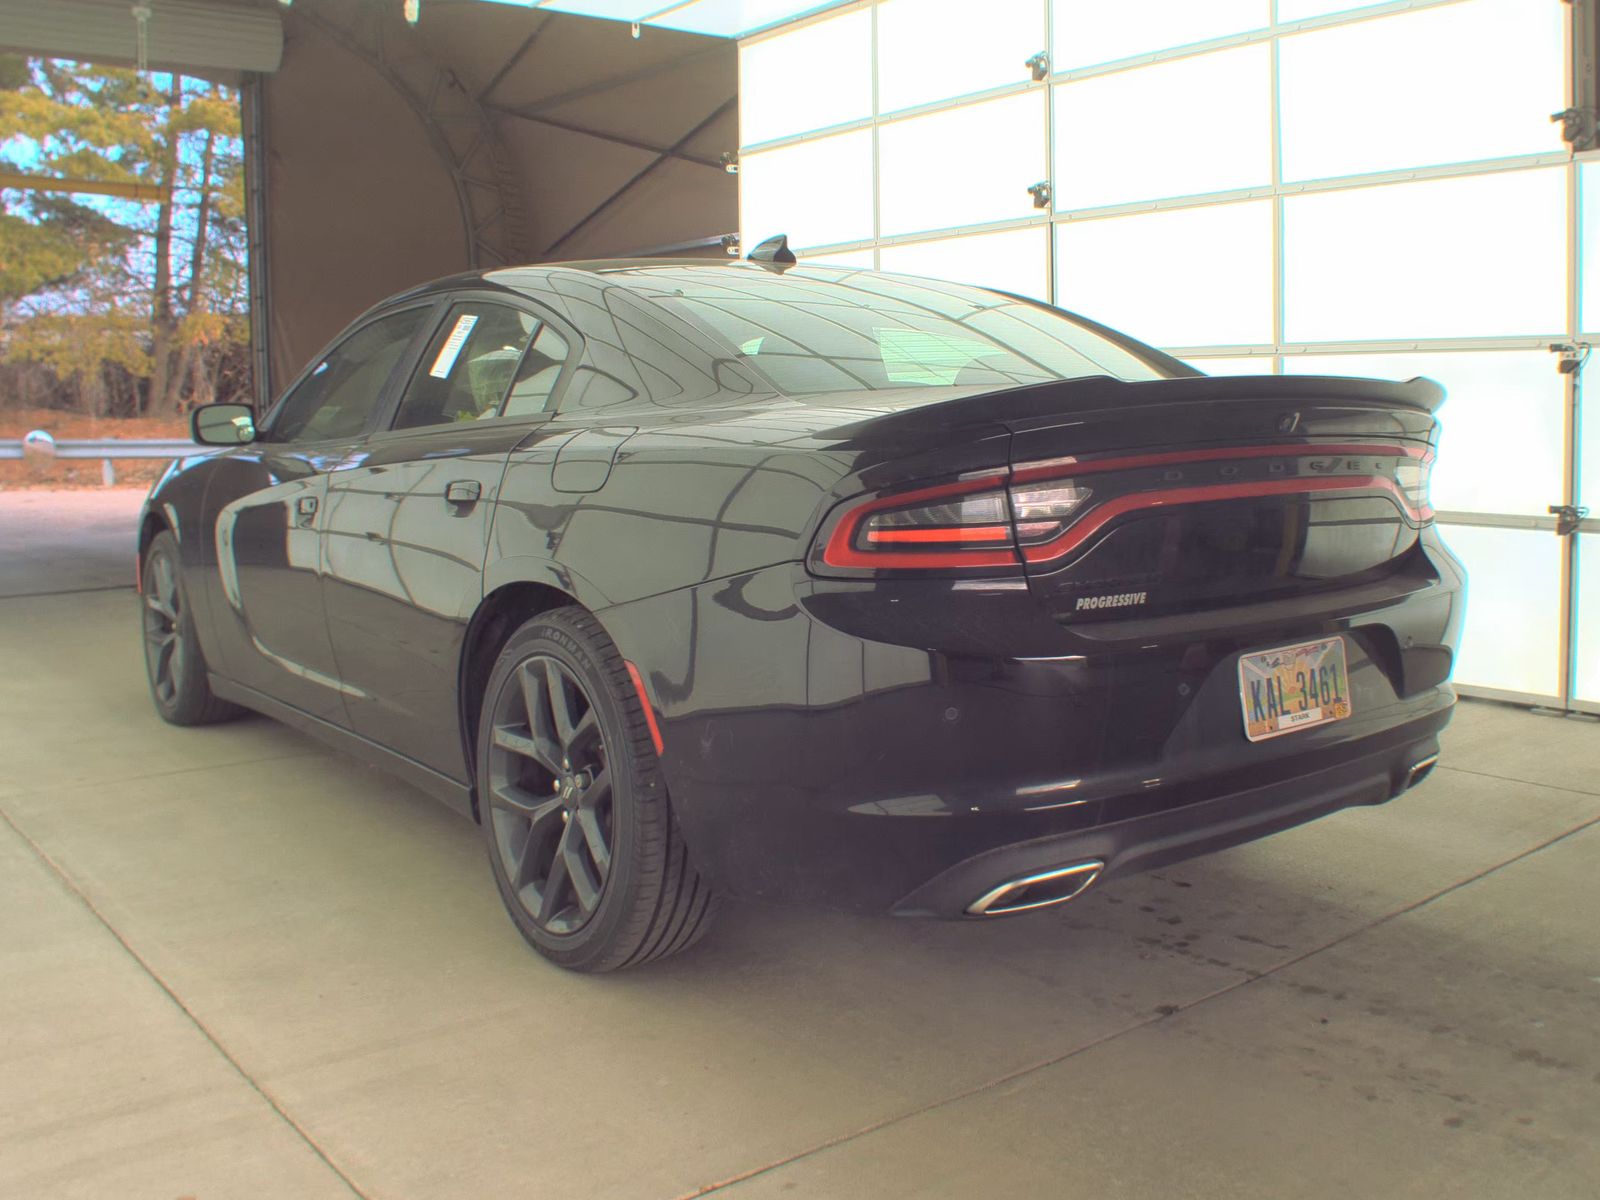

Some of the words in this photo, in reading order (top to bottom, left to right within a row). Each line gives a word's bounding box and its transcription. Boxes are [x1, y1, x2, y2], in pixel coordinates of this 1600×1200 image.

[1075, 592, 1147, 610] PROGRESSIVE
[1250, 675, 1291, 722] KAL
[1295, 663, 1343, 711] 3461
